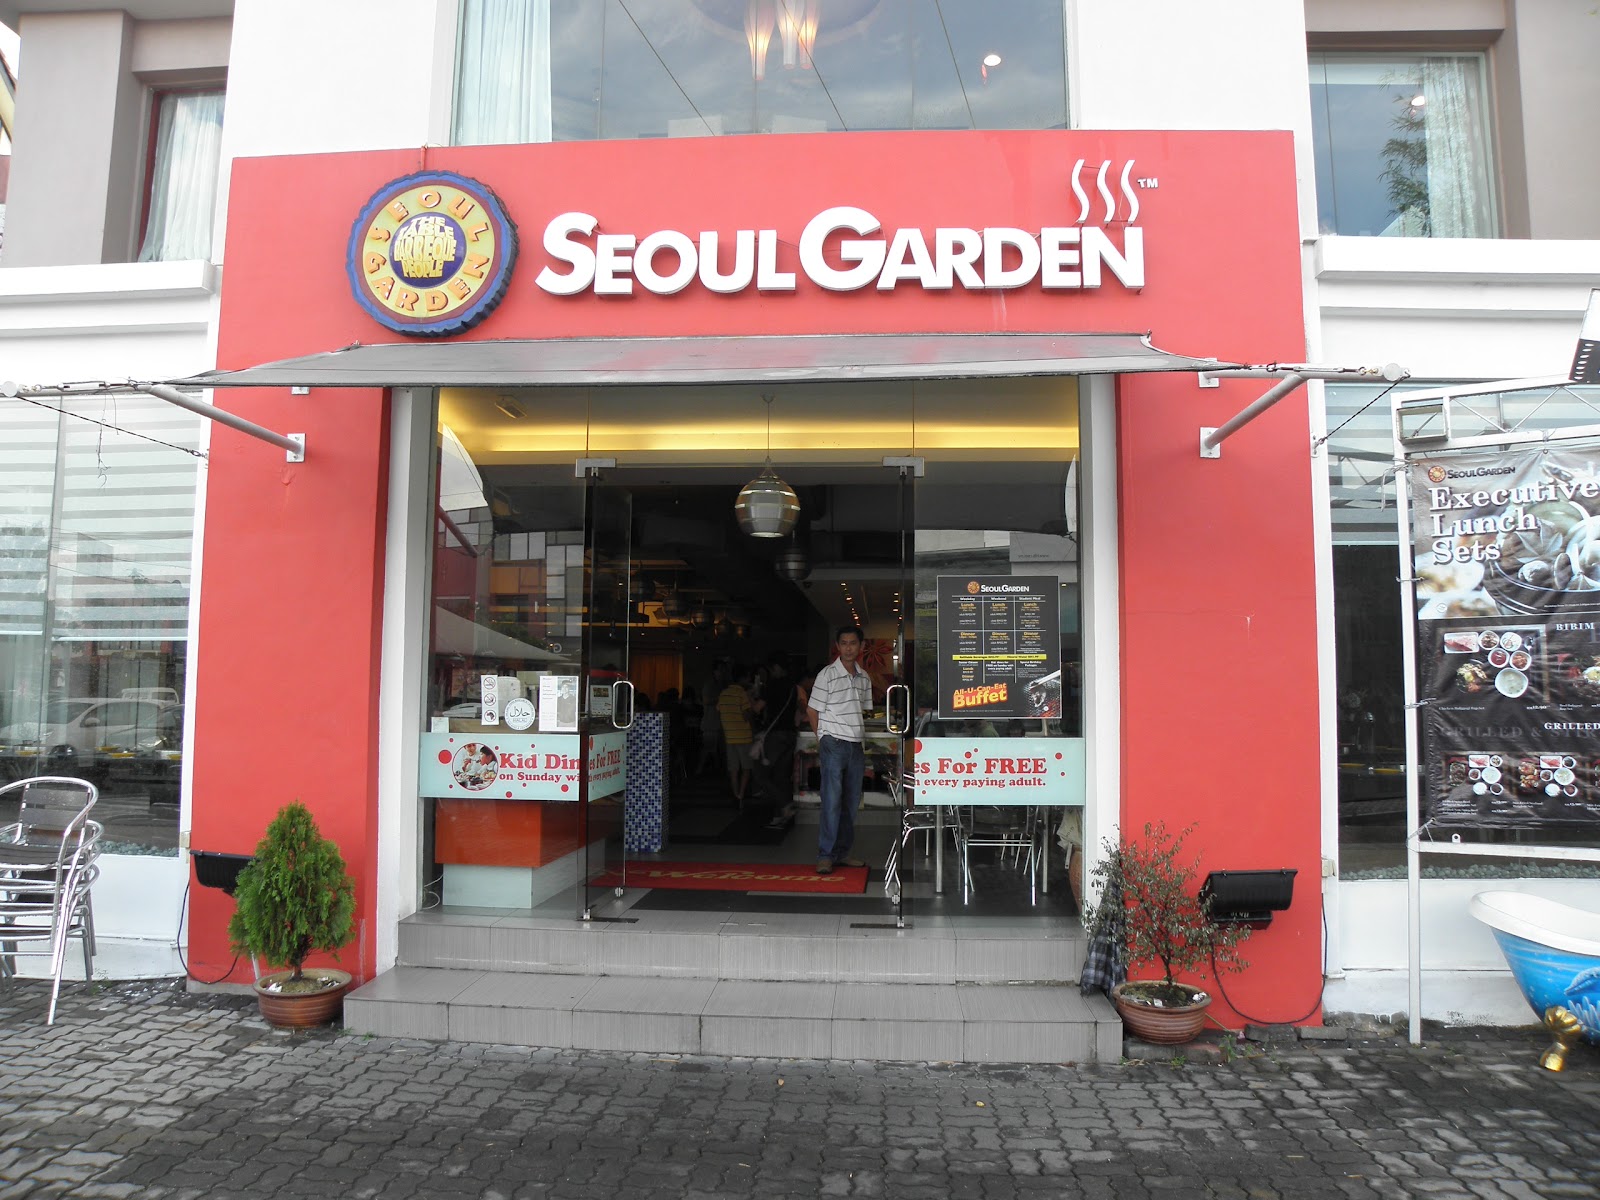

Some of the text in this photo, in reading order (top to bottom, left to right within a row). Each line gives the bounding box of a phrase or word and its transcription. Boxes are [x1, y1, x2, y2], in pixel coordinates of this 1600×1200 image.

[411, 216, 446, 226] THE
[399, 224, 454, 238] TABLE
[535, 206, 1146, 297] SEOUL GARDEN
[401, 260, 444, 278] PEOPLE
[1428, 477, 1600, 512] Executive
[1430, 507, 1538, 538] Lunch
[1431, 537, 1501, 566] Sets
[1555, 622, 1595, 631] BIBIM
[953, 689, 1007, 708] Buffet
[1544, 722, 1600, 730] GRILLED
[499, 753, 538, 770] Kid
[596, 753, 606, 768] For
[607, 749, 620, 766] FREE
[937, 757, 978, 774] For
[984, 757, 1048, 774] FREE
[517, 772, 562, 783] Sunday
[924, 779, 959, 788] every
[962, 777, 1006, 788] paying
[1008, 777, 1046, 787] adult.
[650, 869, 846, 882] Welcome
